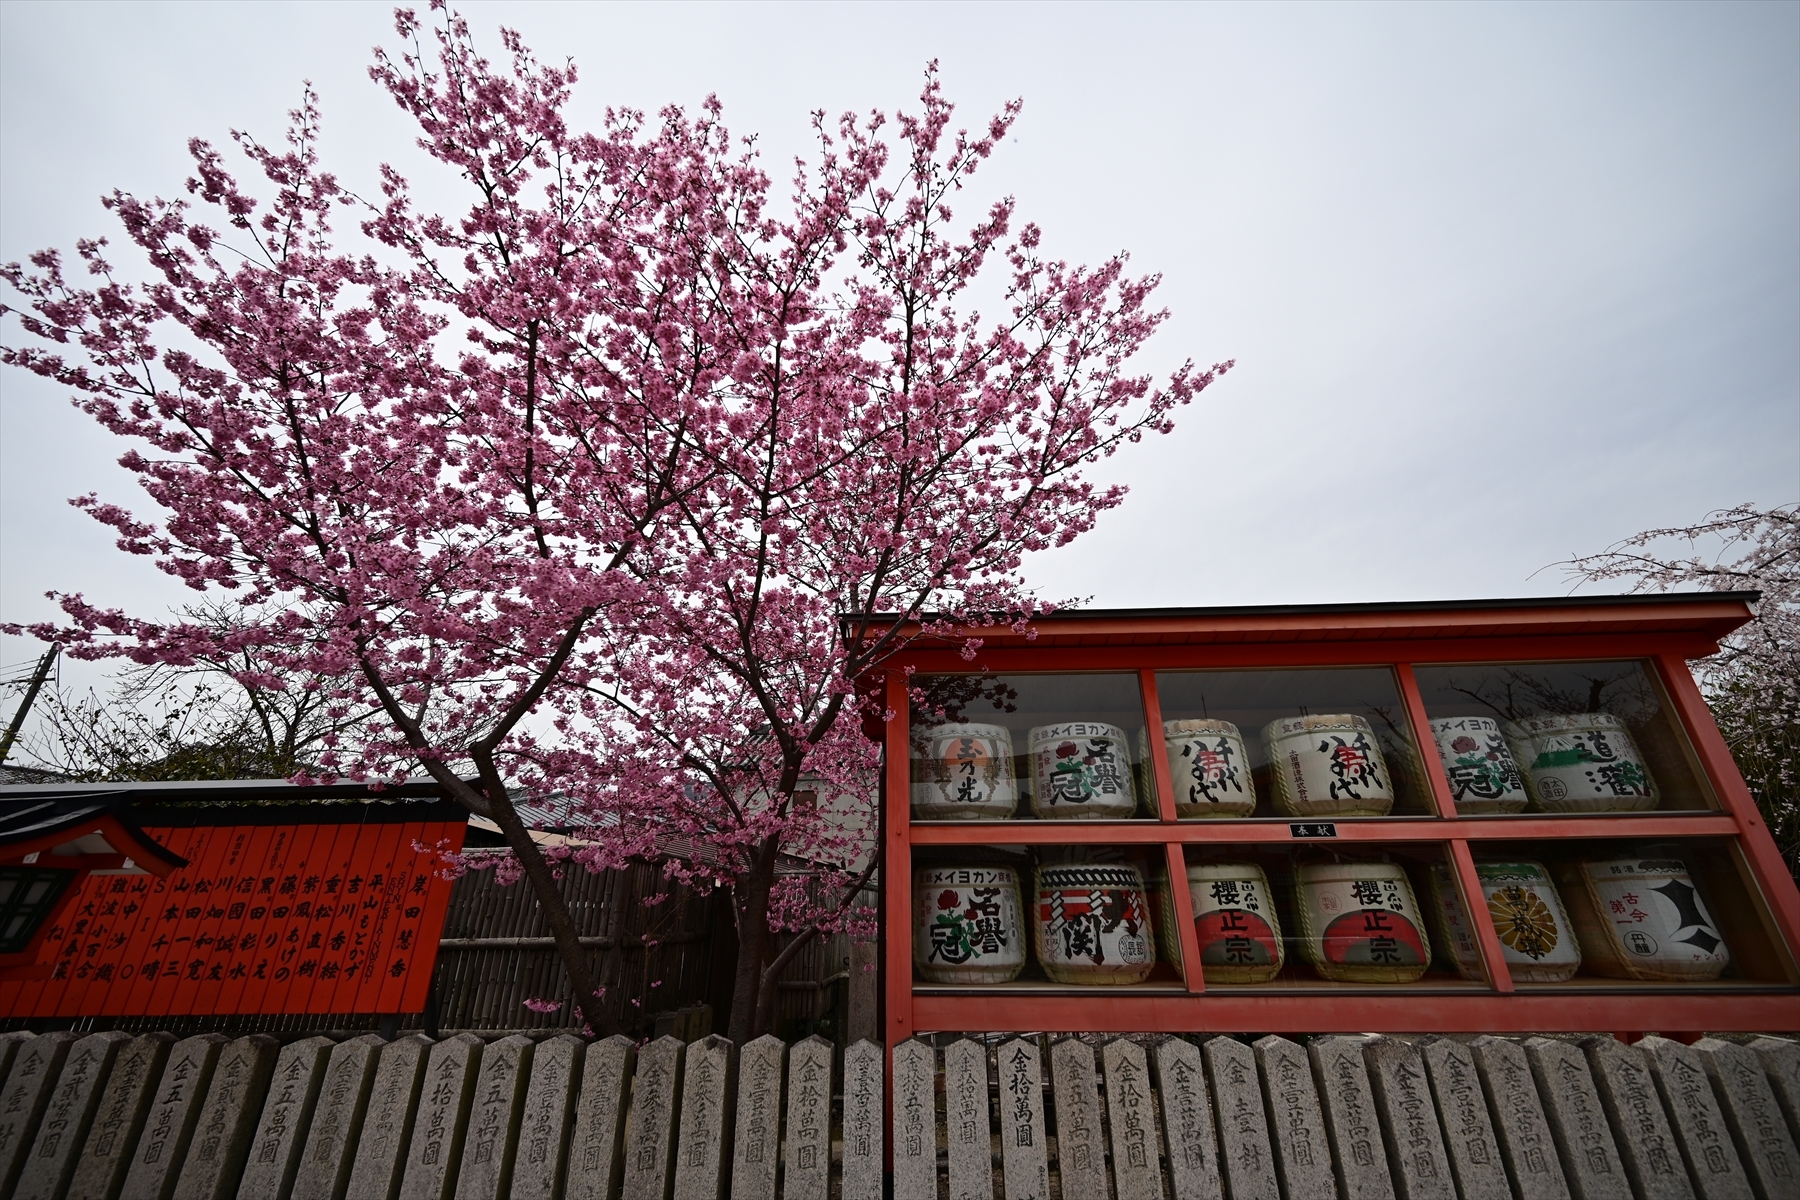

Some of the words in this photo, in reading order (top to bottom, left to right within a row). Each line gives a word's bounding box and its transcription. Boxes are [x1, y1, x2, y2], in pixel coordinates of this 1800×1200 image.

[957, 738, 983, 802] 玉乃光
[1051, 724, 1109, 738] メイヨカン
[1050, 768, 1093, 806] 冠
[392, 871, 407, 904] SHIN
[934, 871, 997, 884] メイヨカン
[1610, 865, 1635, 874] 銘酒
[1610, 900, 1633, 925] 第一
[1622, 892, 1648, 922] 古今
[141, 878, 190, 982] 山本千晴
[162, 878, 213, 978] 松田一三
[227, 877, 275, 981] 黒田彩水
[320, 874, 363, 981] 吉川香絵
[345, 874, 383, 982] 平山もとかず
[364, 877, 397, 984] ENTERTAINMENT
[929, 922, 971, 965] 冠
[143, 1055, 199, 1165] 金五萬圓
[258, 1056, 308, 1164] 金五萬圓
[422, 1055, 461, 1166] 金拾萬圓
[473, 1055, 514, 1165] 金五萬圓
[797, 1056, 825, 1170] 金拾萬圓
[957, 1048, 979, 1145] 金拾萬圓
[1009, 1047, 1034, 1148] 金拾萬圓
[1114, 1056, 1147, 1169] 金拾萬圓
